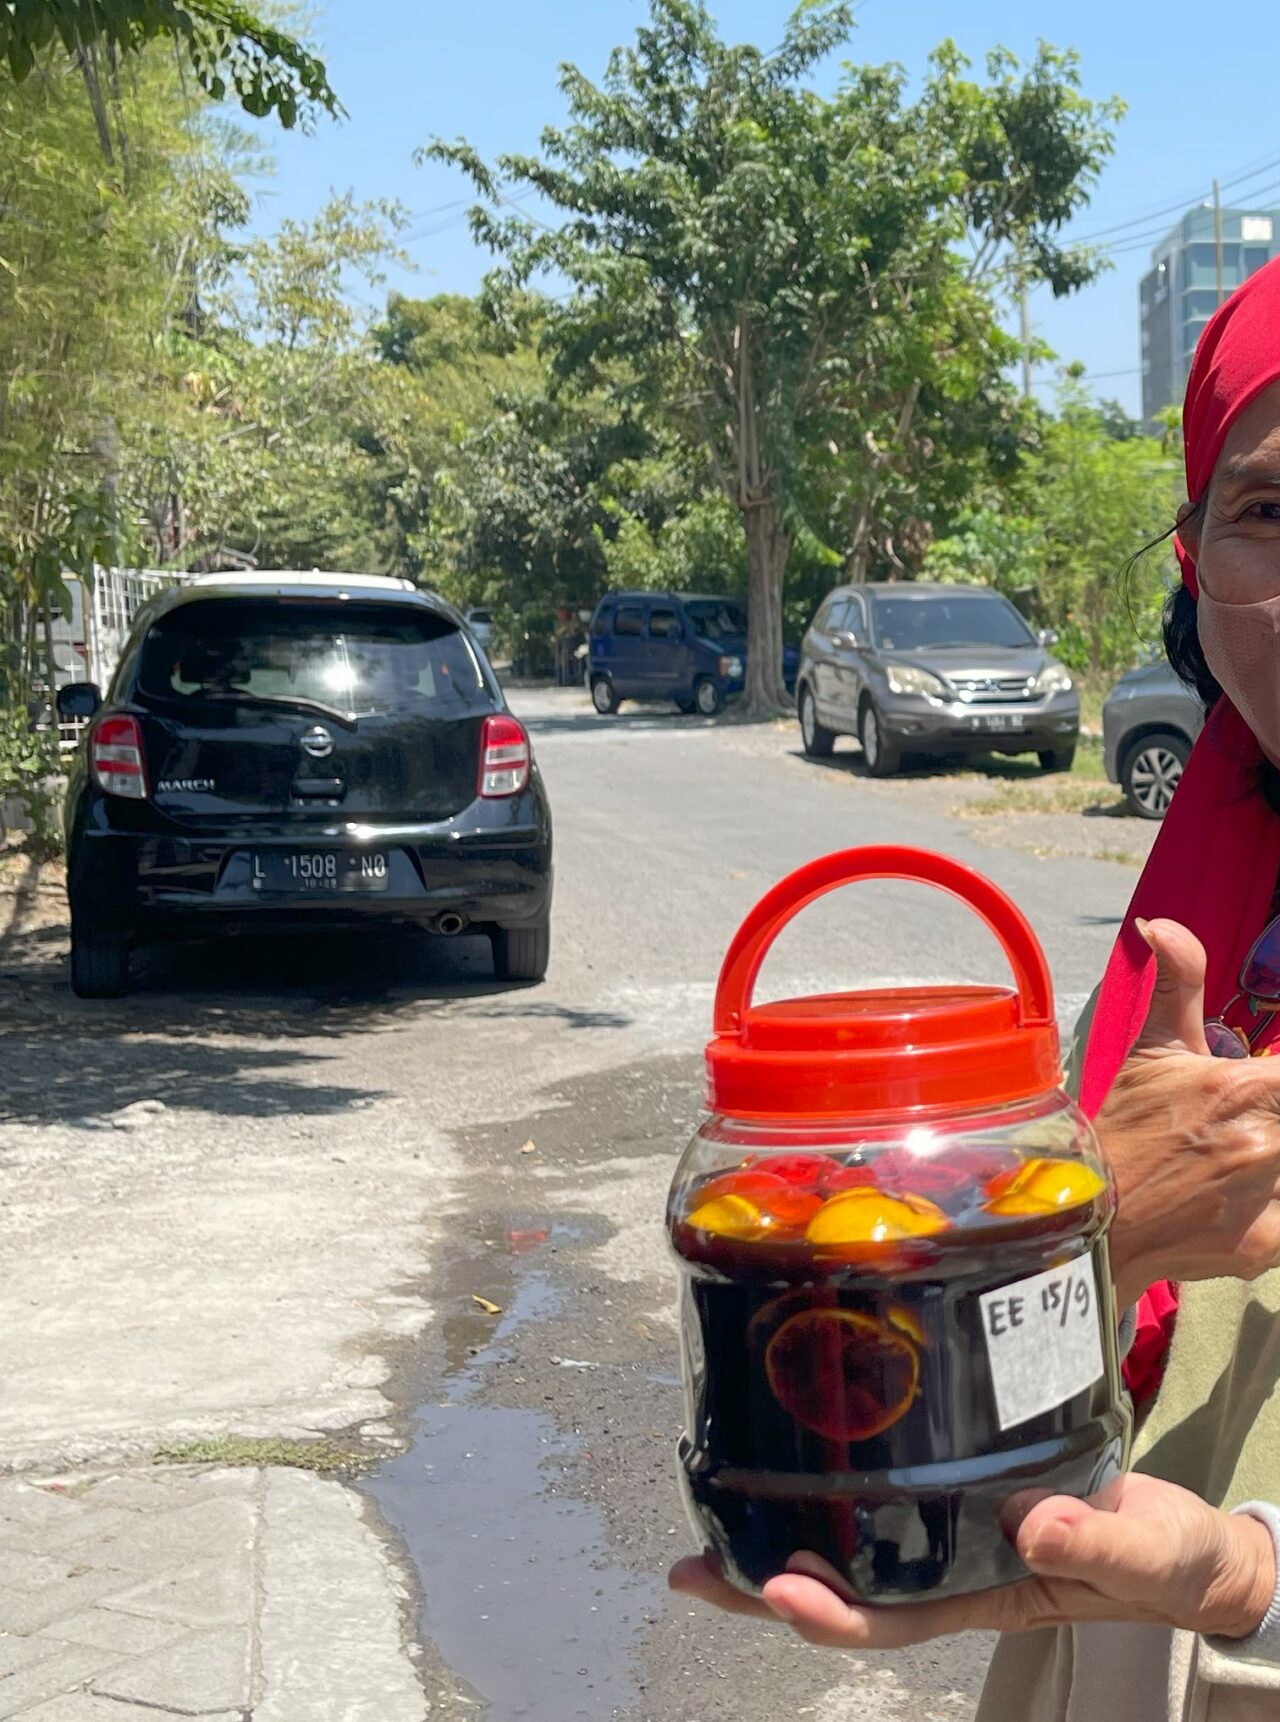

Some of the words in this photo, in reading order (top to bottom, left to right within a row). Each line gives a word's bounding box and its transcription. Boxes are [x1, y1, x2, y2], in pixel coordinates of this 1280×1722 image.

[157, 779, 216, 793] MARCH
[254, 855, 267, 878] L
[291, 854, 336, 878] 1508
[988, 1297, 1024, 1336] EE
[1041, 1276, 1090, 1327] 15/9
